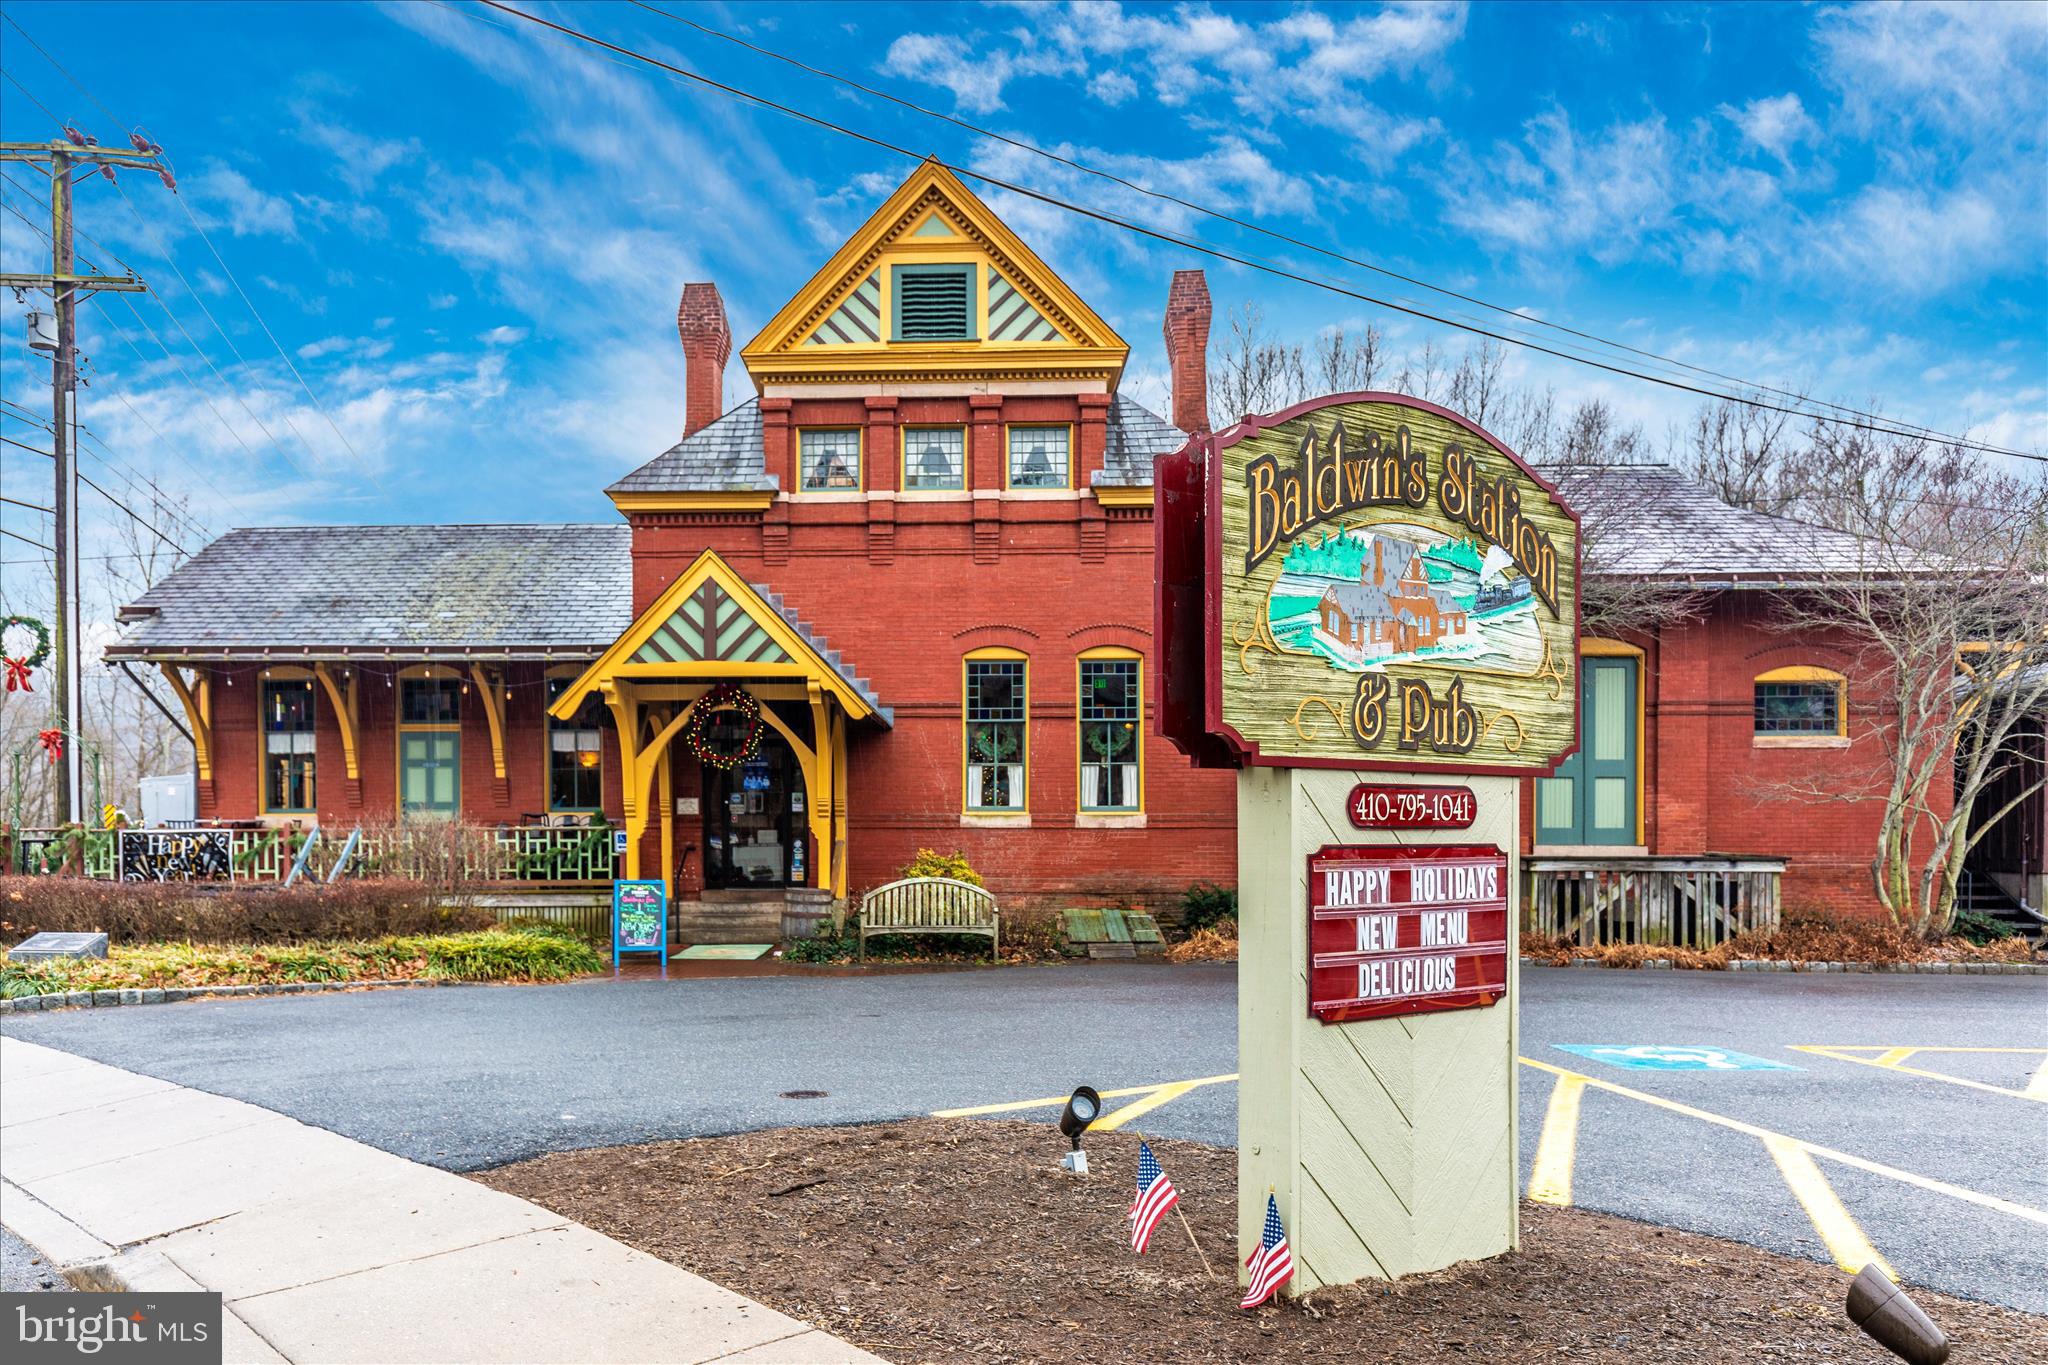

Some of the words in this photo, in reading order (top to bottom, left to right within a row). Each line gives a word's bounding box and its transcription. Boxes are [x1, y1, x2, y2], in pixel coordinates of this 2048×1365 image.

[1247, 424, 1427, 572] Baldwin's
[1440, 445, 1560, 616] Station
[1354, 675, 1388, 747] &
[1400, 676, 1476, 752] Pub
[1356, 792, 1472, 822] 410-795-1041
[147, 834, 200, 858] Happy
[1327, 868, 1391, 907] HAPPY
[1411, 866, 1498, 903] HOLIDAYS
[1358, 915, 1398, 951] NEW
[1421, 911, 1468, 947] MENU
[1358, 957, 1456, 999] DELICIOUS
